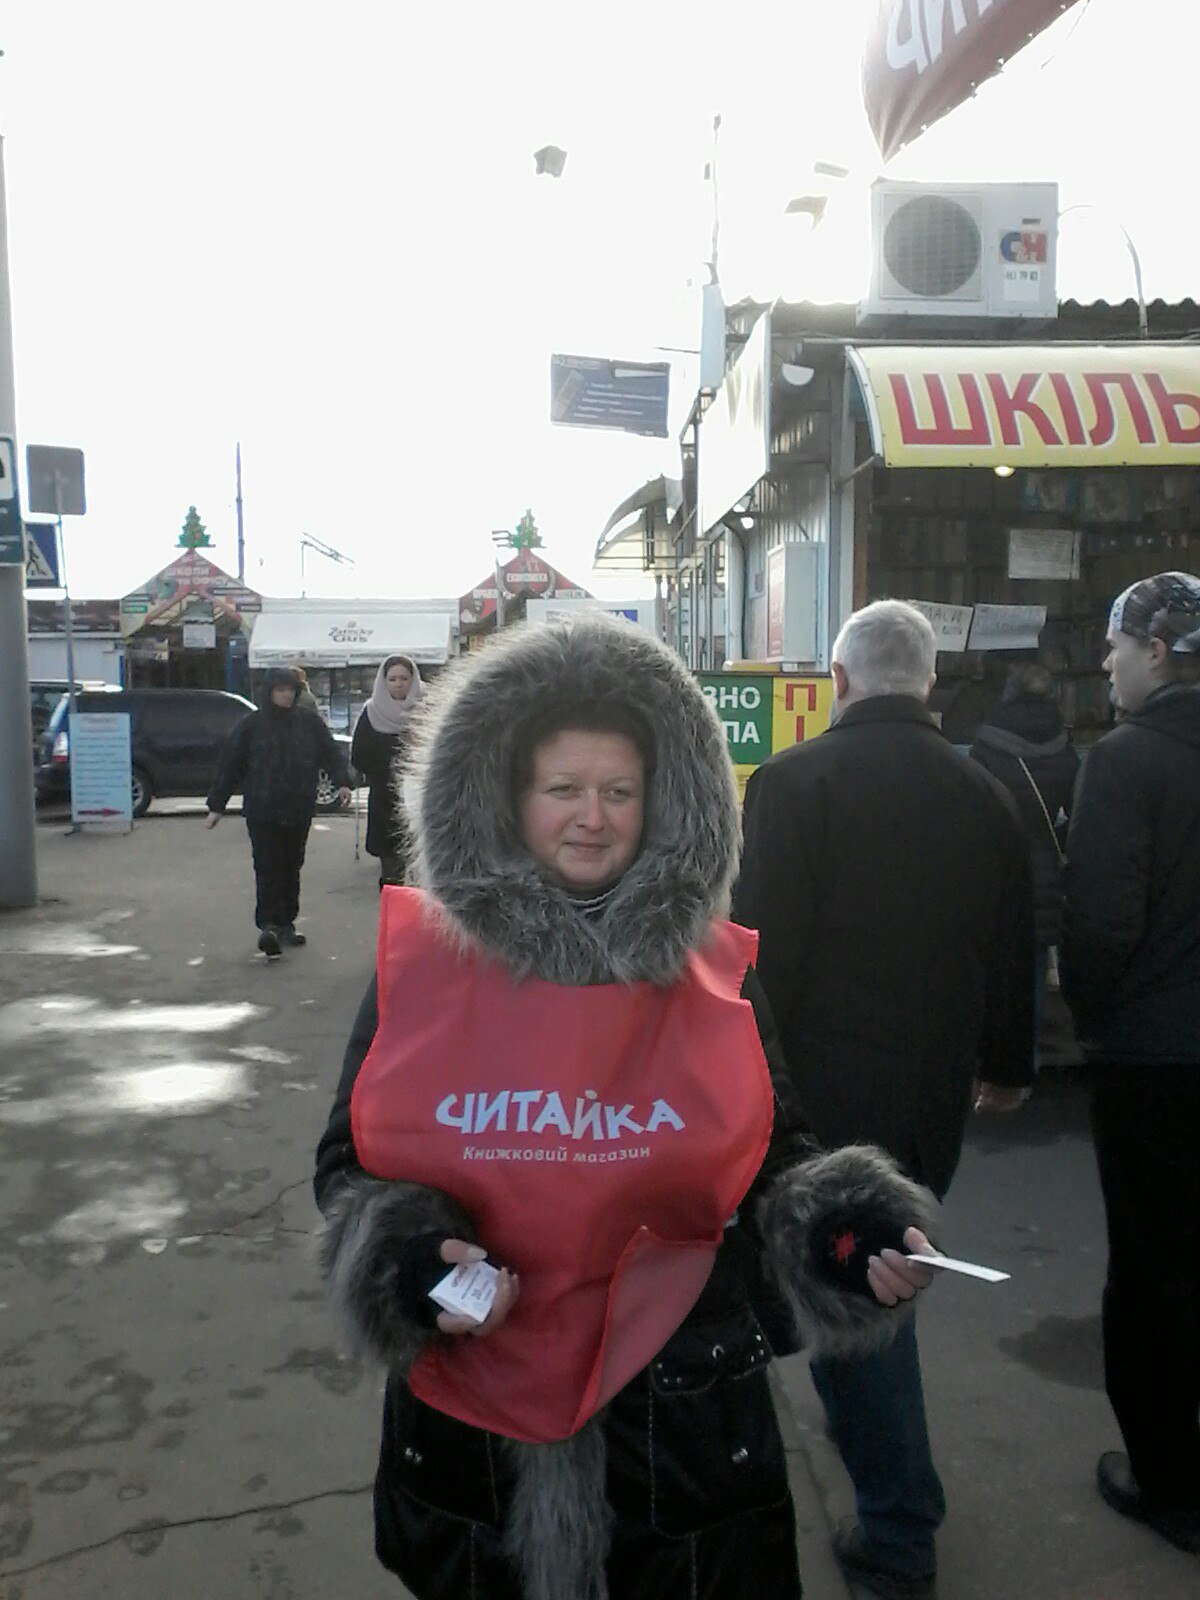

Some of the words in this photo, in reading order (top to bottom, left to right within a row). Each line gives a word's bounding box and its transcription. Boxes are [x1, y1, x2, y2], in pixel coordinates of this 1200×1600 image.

[887, 373, 1200, 447] ШКІЛЬ
[435, 1088, 686, 1141] ЧИТАЙКА
[462, 1146, 568, 1162] Книжковий
[573, 1146, 651, 1163] магазин
